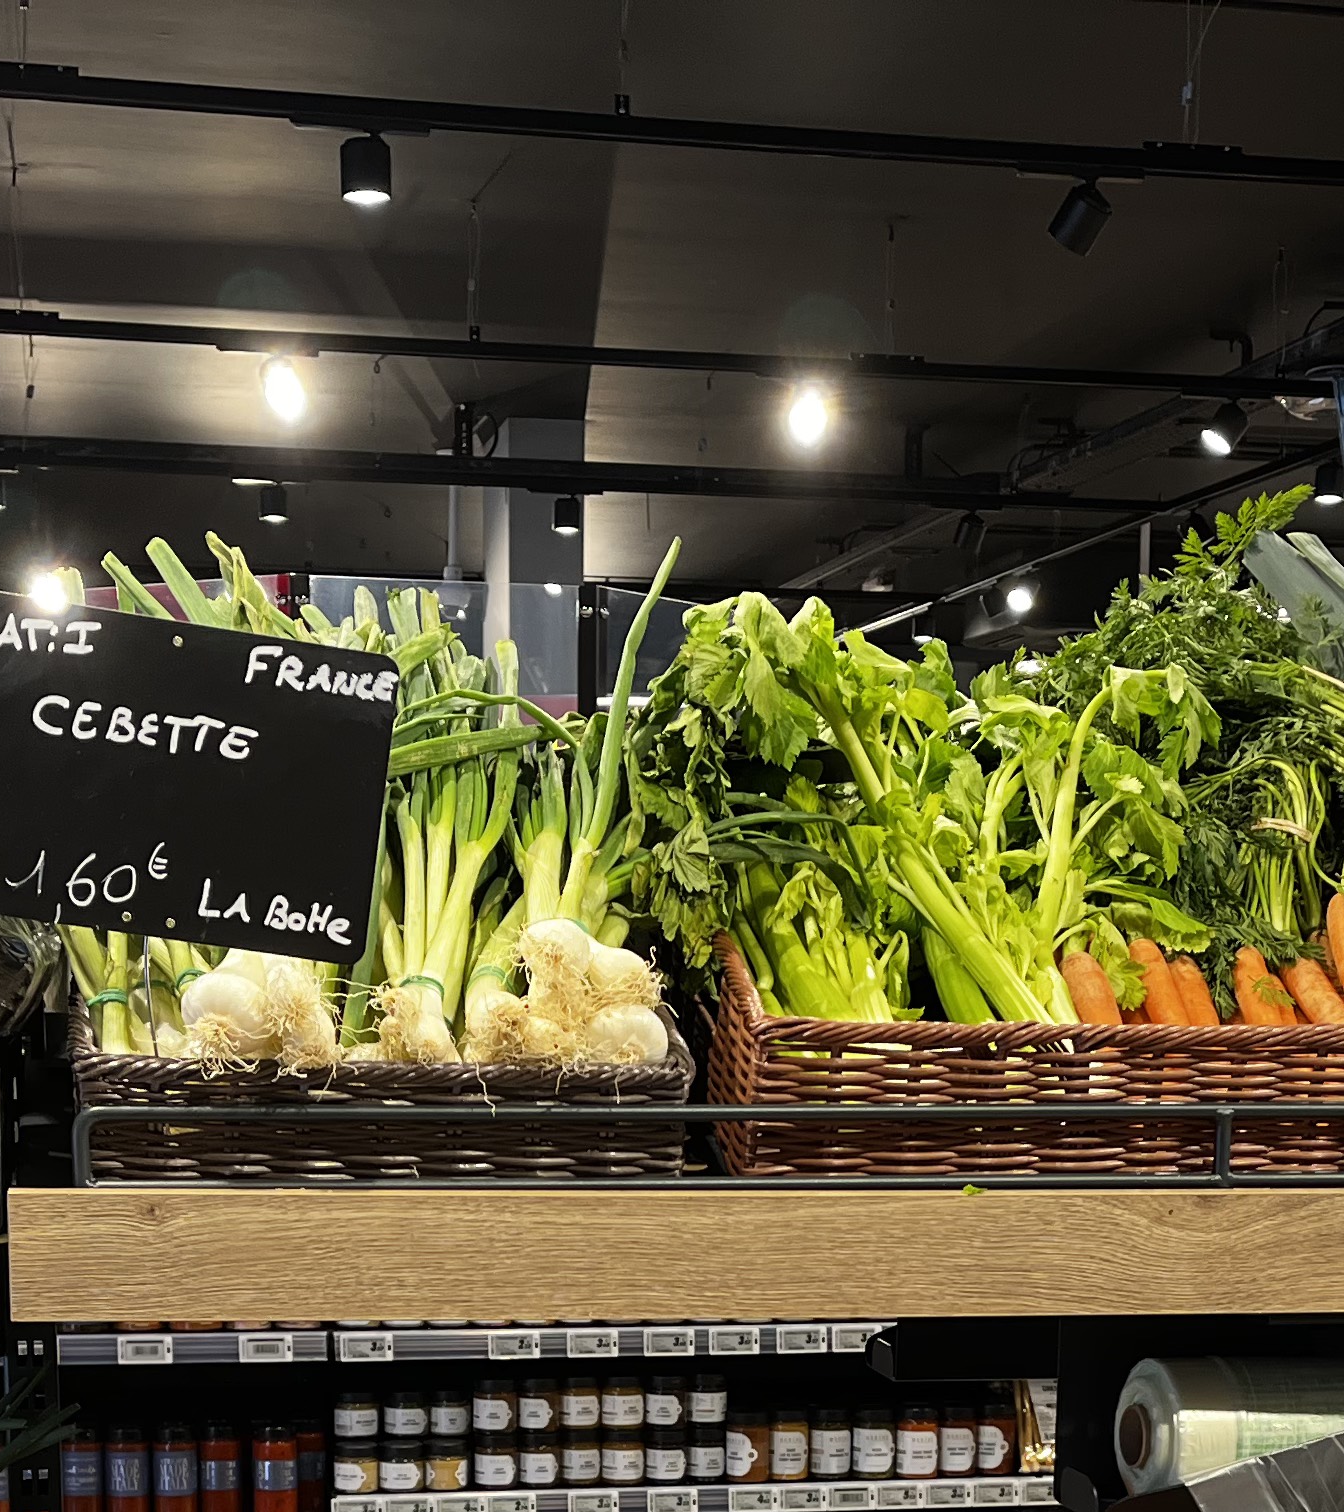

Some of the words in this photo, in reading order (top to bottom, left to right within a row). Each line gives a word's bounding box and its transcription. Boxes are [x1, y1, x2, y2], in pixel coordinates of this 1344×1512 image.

[244, 646, 399, 701] FRANCE
[33, 695, 258, 759] CEBETTE
[198, 878, 250, 922] LA
